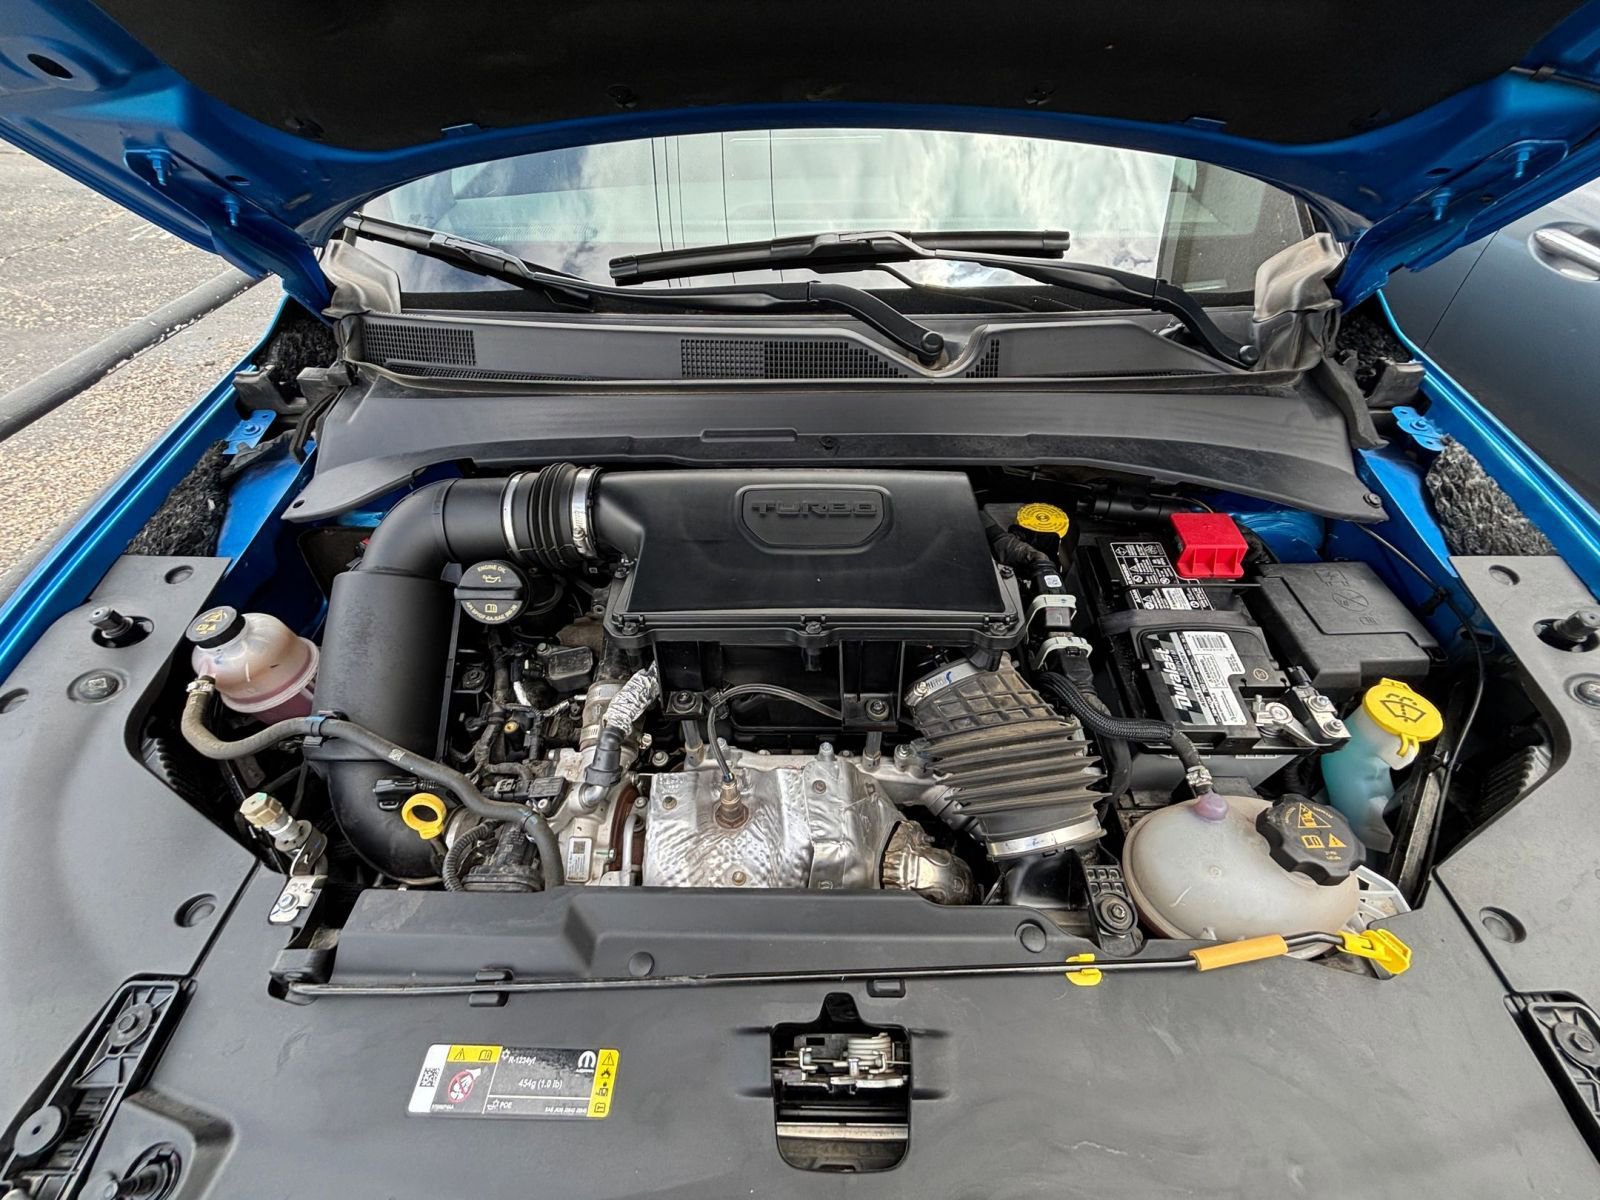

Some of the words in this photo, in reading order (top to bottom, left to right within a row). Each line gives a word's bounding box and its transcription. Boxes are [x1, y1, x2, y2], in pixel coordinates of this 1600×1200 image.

[751, 500, 878, 518] TURBO
[497, 566, 506, 574] OIL
[1169, 649, 1190, 689] PLATINUM
[1152, 647, 1193, 710] Duralast
[518, 1078, 536, 1090] 454g
[537, 1079, 551, 1090] (1.0
[552, 1079, 563, 1090] lb)
